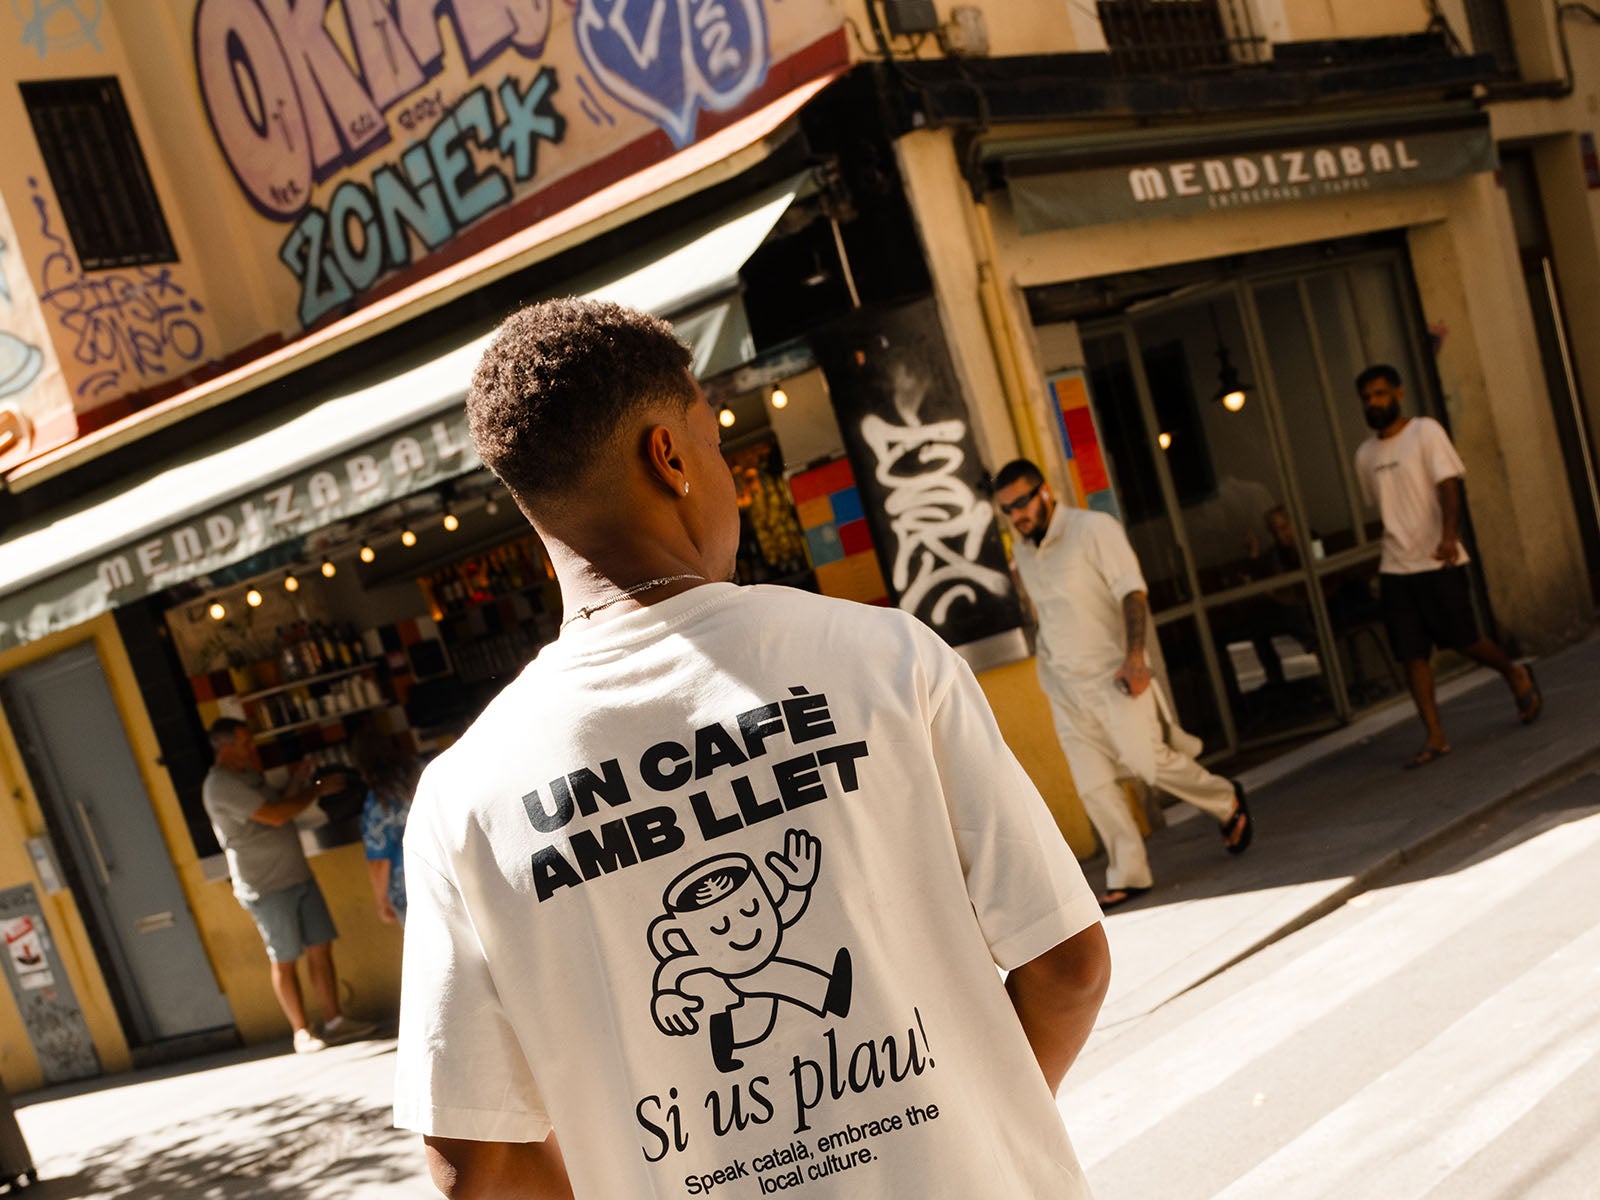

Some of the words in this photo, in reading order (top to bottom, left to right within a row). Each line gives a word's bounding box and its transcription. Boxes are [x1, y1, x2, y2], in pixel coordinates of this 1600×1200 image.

[1128, 140, 1419, 202] MENDIZABAL
[97, 422, 467, 594] MENDIZABAL
[521, 757, 632, 834] UN
[639, 685, 837, 792] CAFÈ
[530, 805, 686, 903] AMB
[688, 740, 870, 842] LLET
[635, 1086, 690, 1163] Si
[704, 1075, 775, 1137] us
[789, 1006, 936, 1134] plau!
[684, 1159, 751, 1196] Speak
[752, 1139, 815, 1173] català,
[817, 1114, 904, 1153] embrace
[905, 1103, 940, 1127] the
[758, 1165, 804, 1196] local
[808, 1148, 879, 1181] culture.
